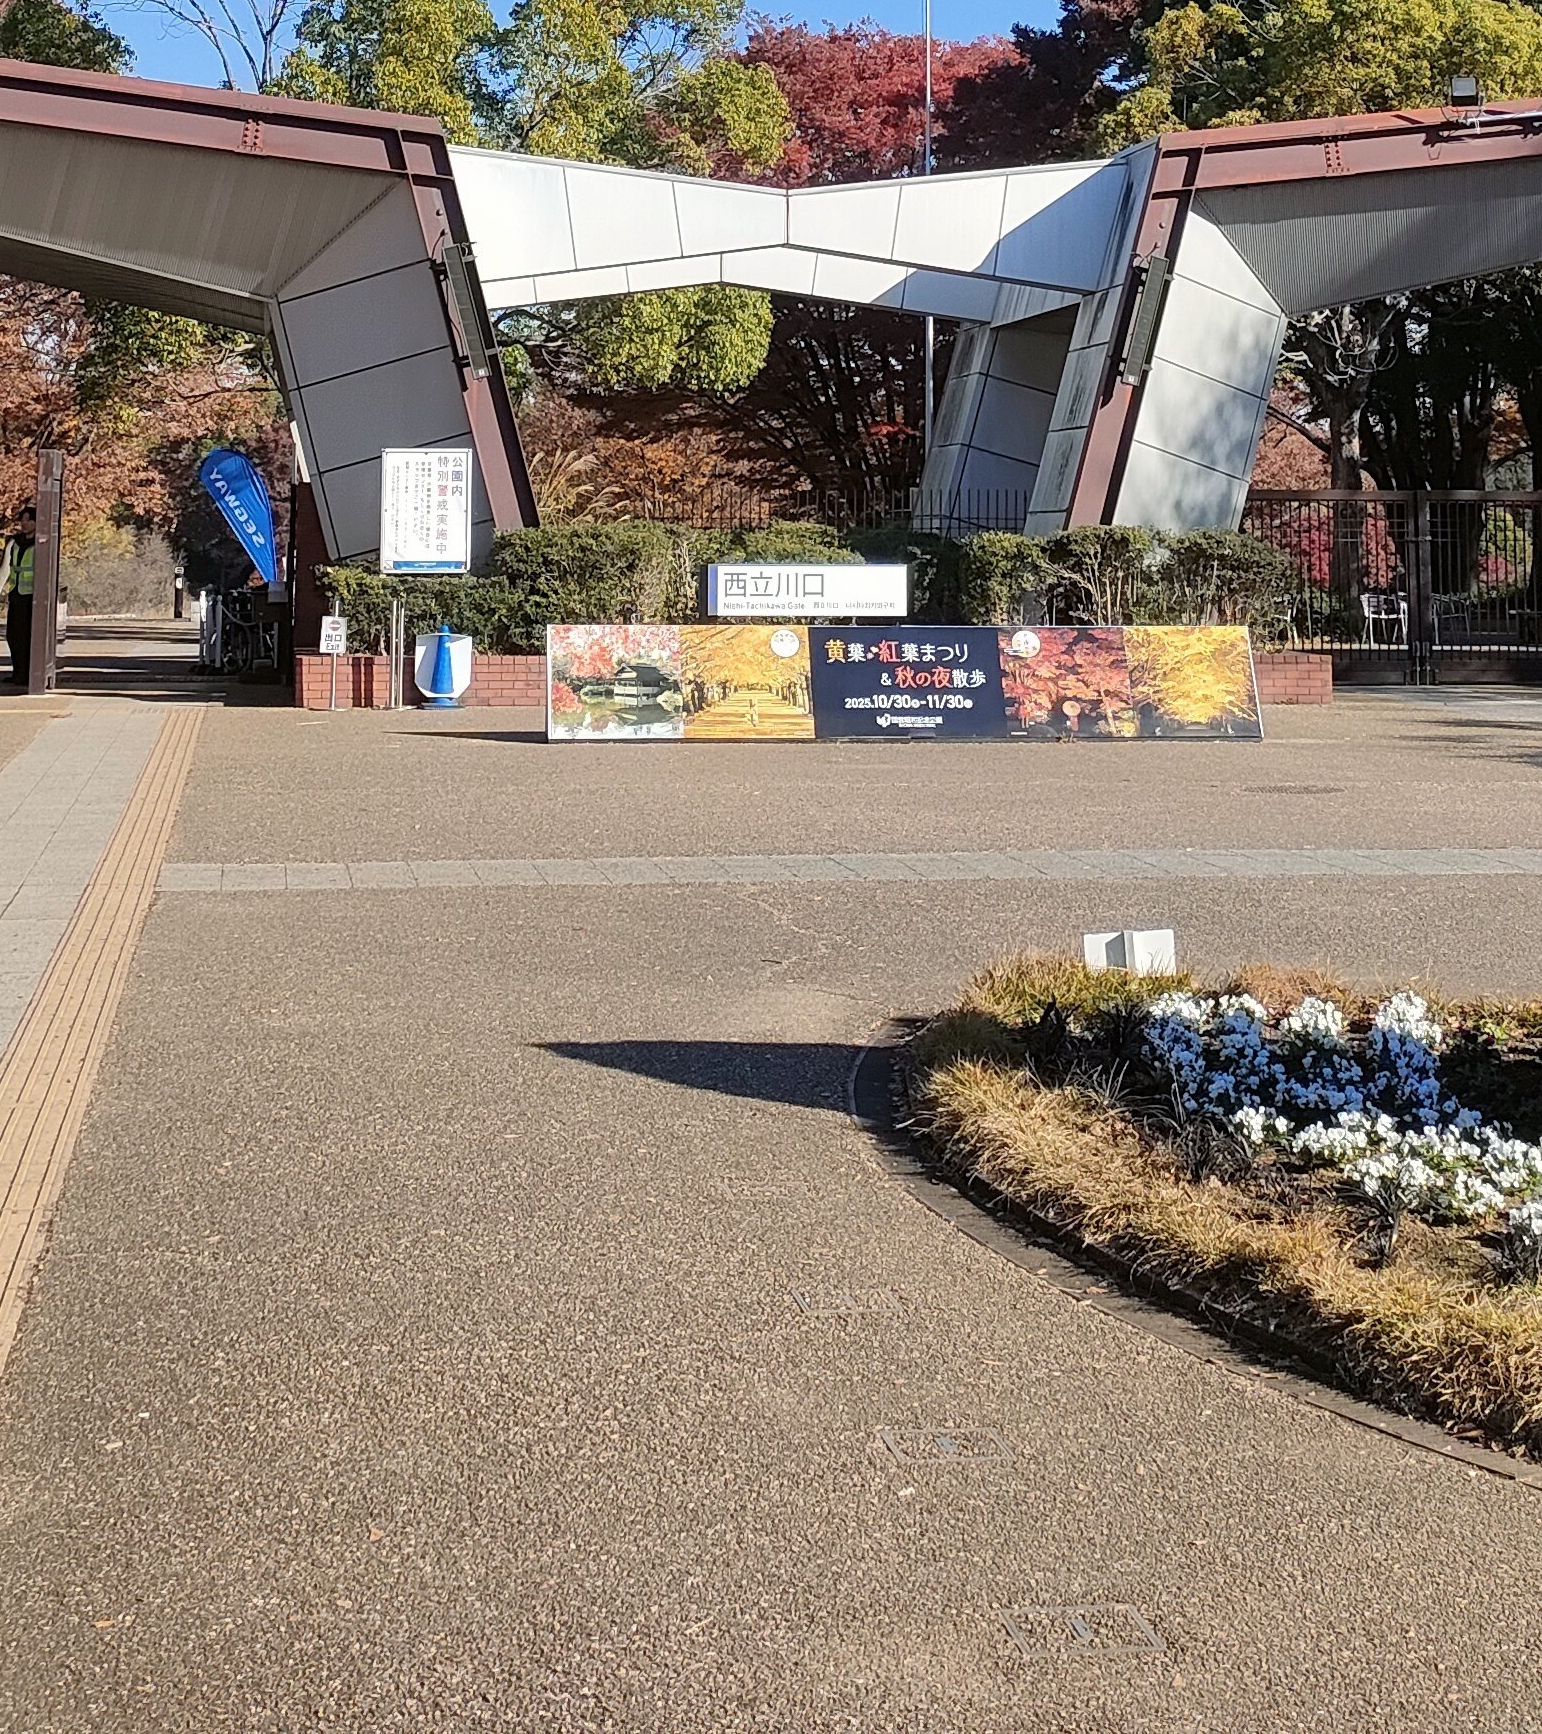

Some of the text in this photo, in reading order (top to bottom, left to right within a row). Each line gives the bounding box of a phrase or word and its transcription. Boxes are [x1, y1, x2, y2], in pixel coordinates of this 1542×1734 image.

[451, 456, 464, 497] 公園内
[723, 571, 825, 598] 西立川口
[787, 601, 805, 610] Gate
[325, 633, 342, 643] 出口
[326, 643, 340, 652] Exit
[880, 666, 987, 689] & 秋の夜散歩
